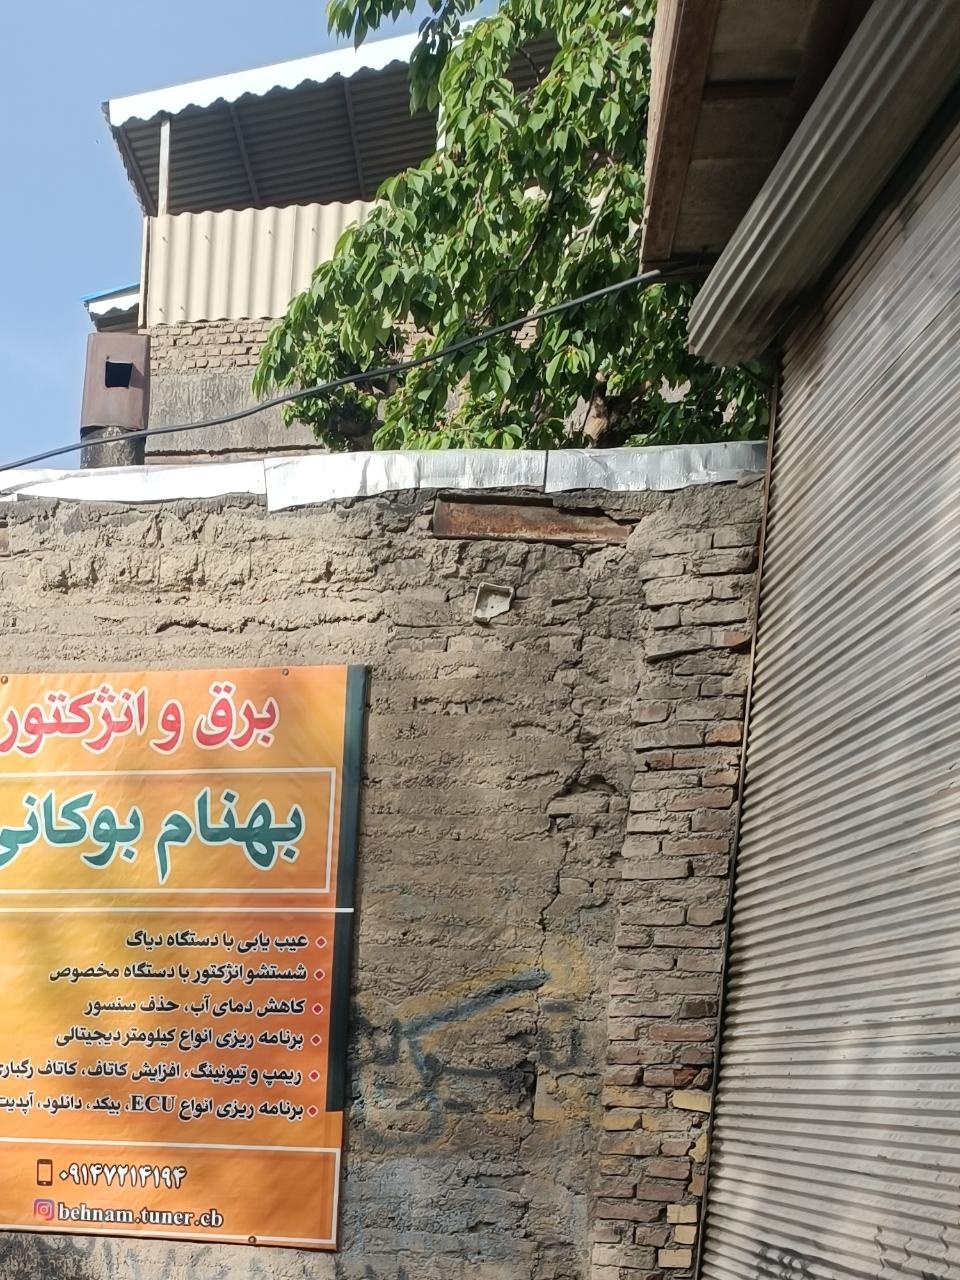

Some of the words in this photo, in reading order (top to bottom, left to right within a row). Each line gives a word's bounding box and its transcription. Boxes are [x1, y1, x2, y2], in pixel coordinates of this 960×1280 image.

[193, 681, 280, 750] برق
[151, 699, 184, 753] و
[154, 785, 306, 885] بهنام
[126, 930, 163, 950] دیاگ
[166, 930, 219, 948] دستگاه
[222, 931, 234, 950] با
[237, 932, 270, 952] یابی
[275, 937, 308, 951] عیب
[50, 962, 119, 984] مخصوص
[124, 962, 175, 979] دستگاه
[178, 964, 190, 980] با
[192, 963, 243, 984] انژکتور
[246, 963, 307, 984] شستشو
[84, 998, 136, 1016] سنسور
[141, 996, 180, 1014] حذف
[213, 999, 253, 1017] دمای
[257, 998, 305, 1017] کاهش
[56, 1027, 121, 1047] دیجیتالی
[124, 1029, 176, 1048] کیلومتر
[178, 1029, 212, 1051] انواع
[216, 1031, 254, 1048] ریزی
[258, 1031, 304, 1049] برنامه
[38, 1060, 77, 1077] کاتاف
[132, 1063, 180, 1082] افزایش
[249, 1069, 258, 1085] و
[262, 1068, 302, 1087] ریمپ
[178, 1098, 213, 1120] انواع
[216, 1099, 254, 1118] ریزی
[258, 1100, 304, 1119] برنامه
[59, 1162, 187, 1189] ۰۹۱۴۷۲۱۴۱۹۴
[57, 1201, 224, 1228] behnam.tuner.cb
